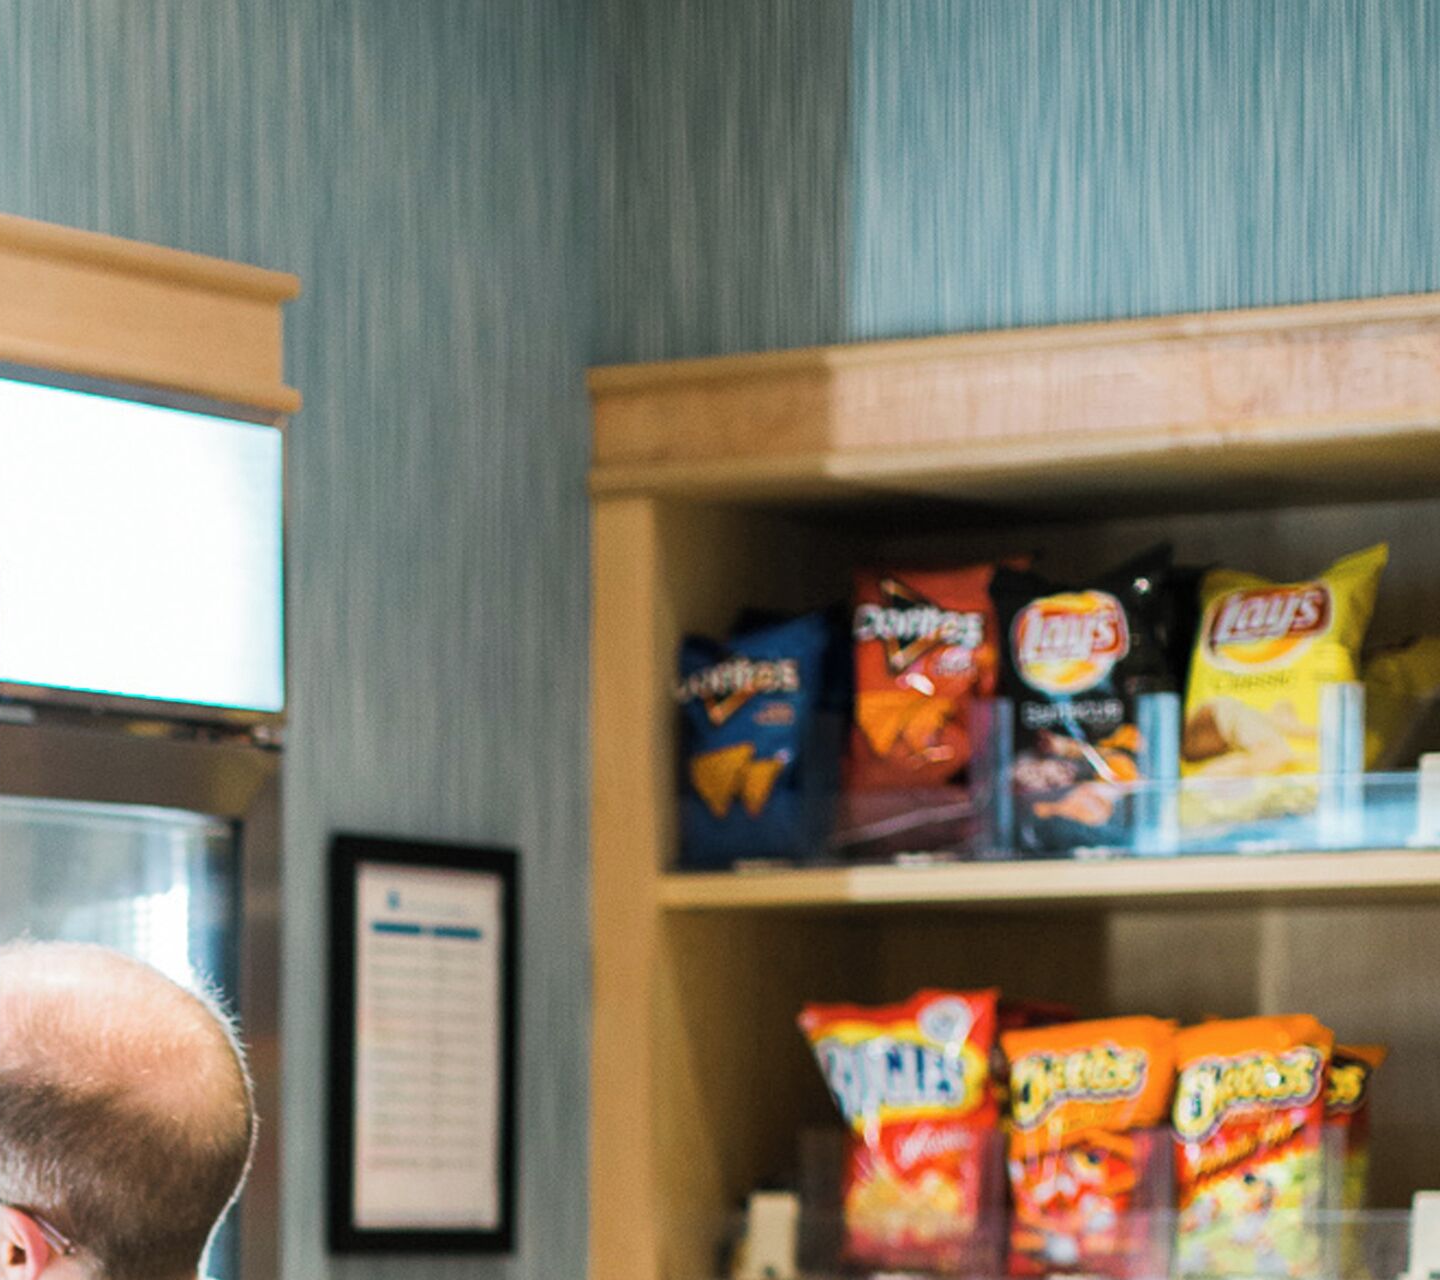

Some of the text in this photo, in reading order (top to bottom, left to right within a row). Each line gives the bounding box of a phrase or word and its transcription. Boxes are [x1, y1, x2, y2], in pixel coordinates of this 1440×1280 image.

[853, 603, 984, 650] Doritos
[1018, 608, 1118, 661] Lay's
[1213, 586, 1321, 646] Lay's
